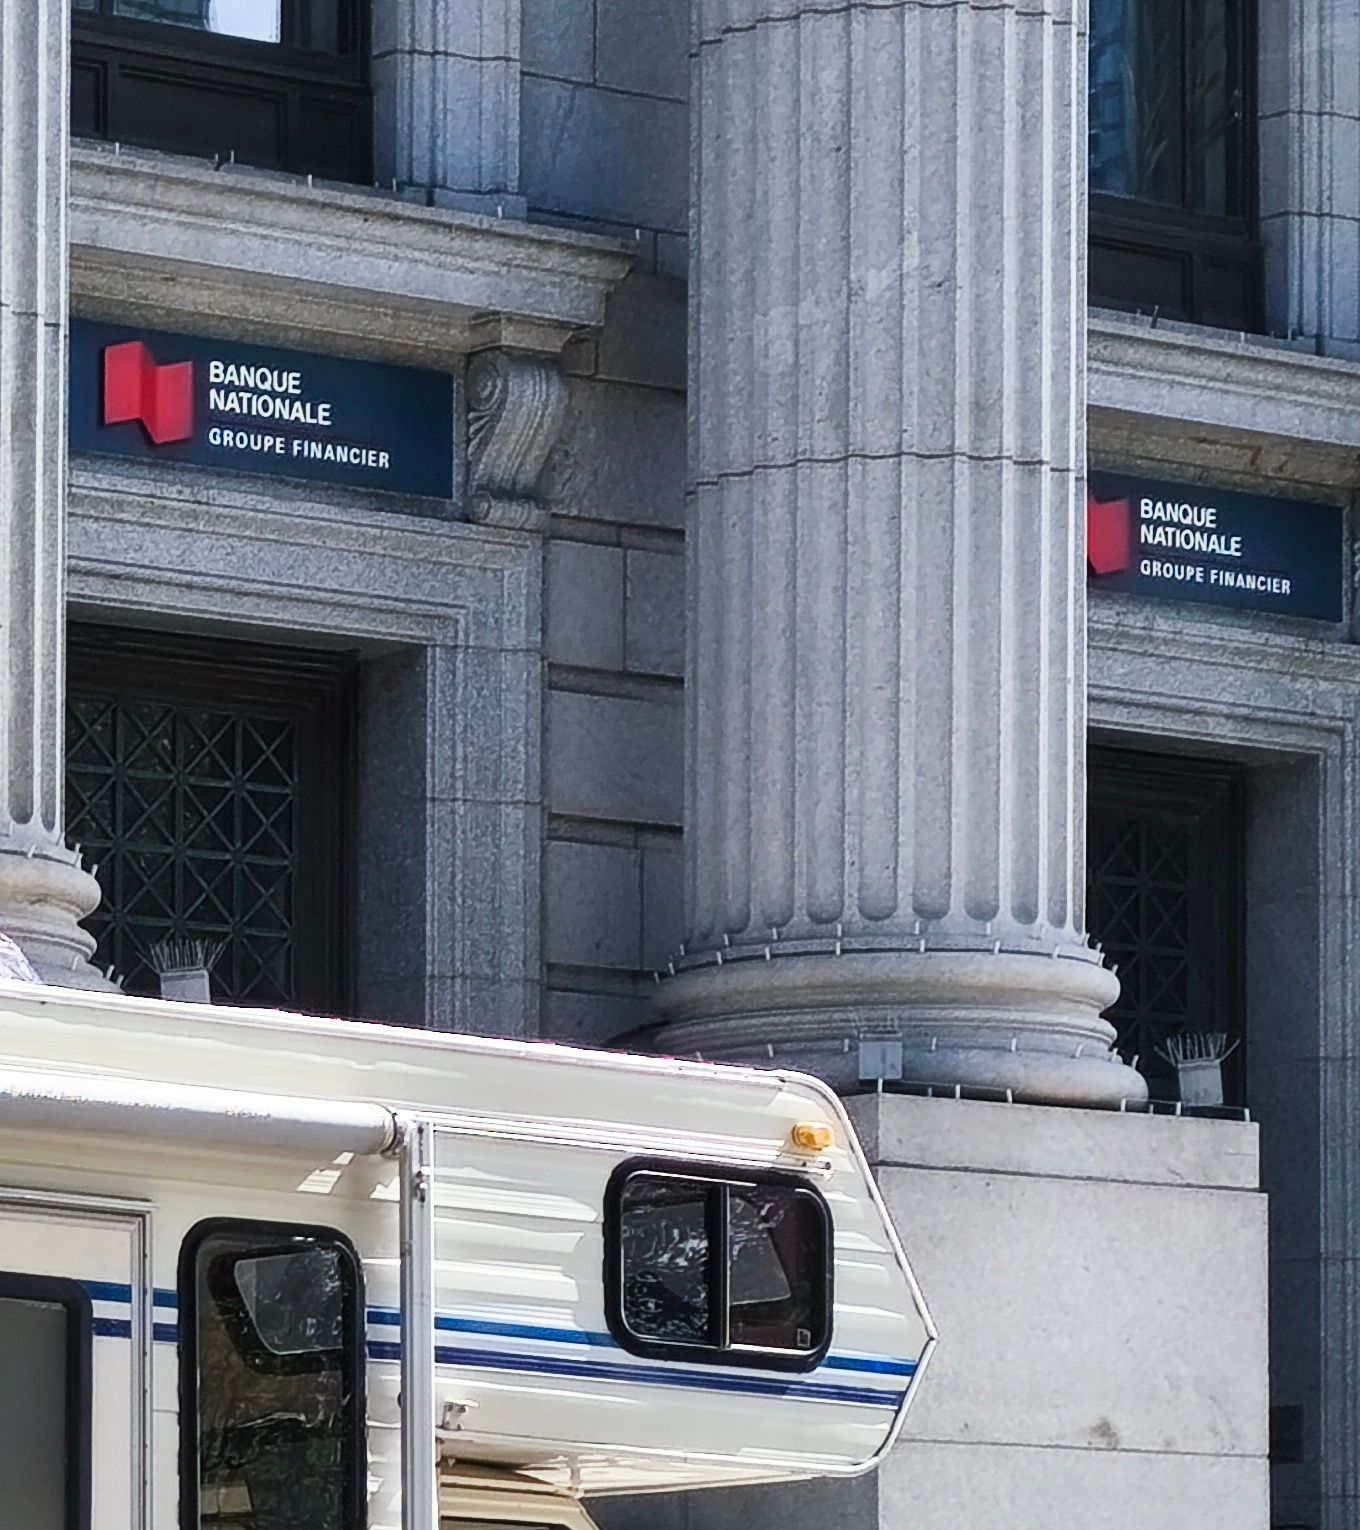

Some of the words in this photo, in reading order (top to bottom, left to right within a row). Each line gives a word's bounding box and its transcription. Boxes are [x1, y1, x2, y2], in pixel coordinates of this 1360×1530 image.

[209, 360, 301, 395] BANQUE
[209, 389, 332, 426] NATIONALE
[208, 427, 286, 454] GROUPE
[292, 438, 391, 469] FINANCIER
[1140, 498, 1217, 529] BANQUE
[1140, 524, 1243, 557] NATIONALE
[1139, 559, 1204, 583] GROUPE
[1209, 568, 1292, 595] FINANCIER
